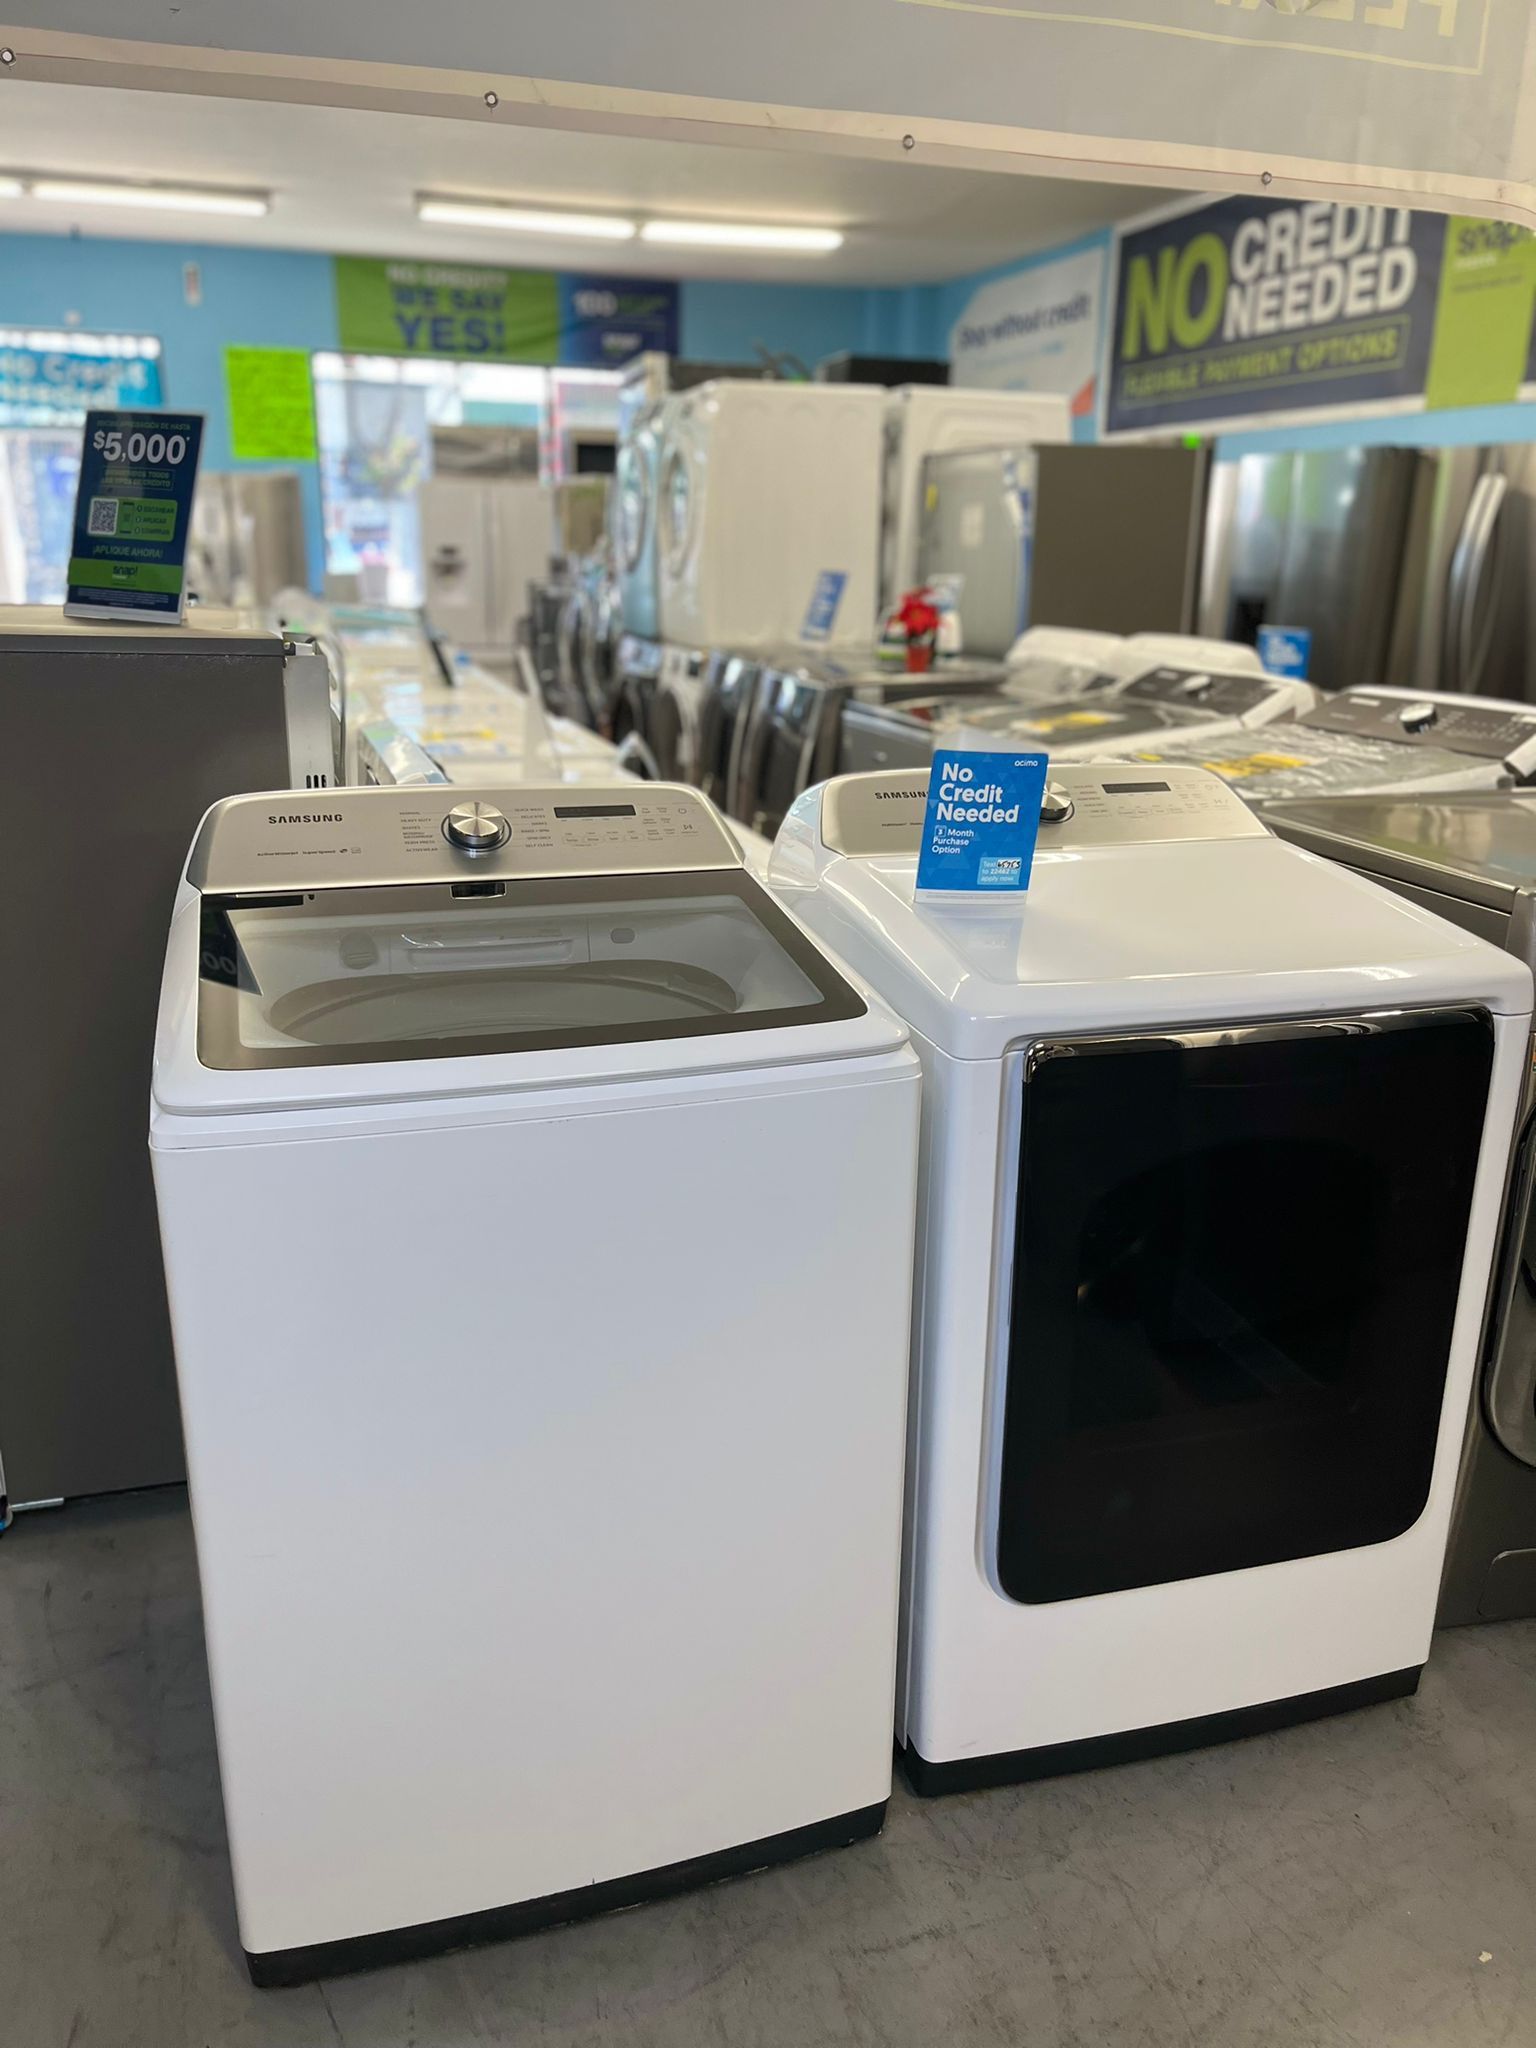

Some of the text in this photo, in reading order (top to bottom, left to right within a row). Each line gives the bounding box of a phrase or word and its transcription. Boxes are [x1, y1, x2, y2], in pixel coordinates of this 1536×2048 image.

[1231, 202, 1412, 282] CREDIT
[1122, 233, 1229, 361] NO
[1223, 247, 1418, 342] NEEDED
[395, 314, 506, 354] YES!
[1125, 328, 1397, 398] FLEXIBLE PAYMENT OPTIONS
[942, 763, 974, 782] No
[875, 791, 928, 800] SAMSUN
[939, 783, 1003, 804] Credit
[268, 813, 343, 824] SAMSUNG
[936, 803, 1020, 823] Needed
[933, 837, 970, 846] Purchase
[948, 828, 974, 838] Month
[931, 846, 961, 855] Option
